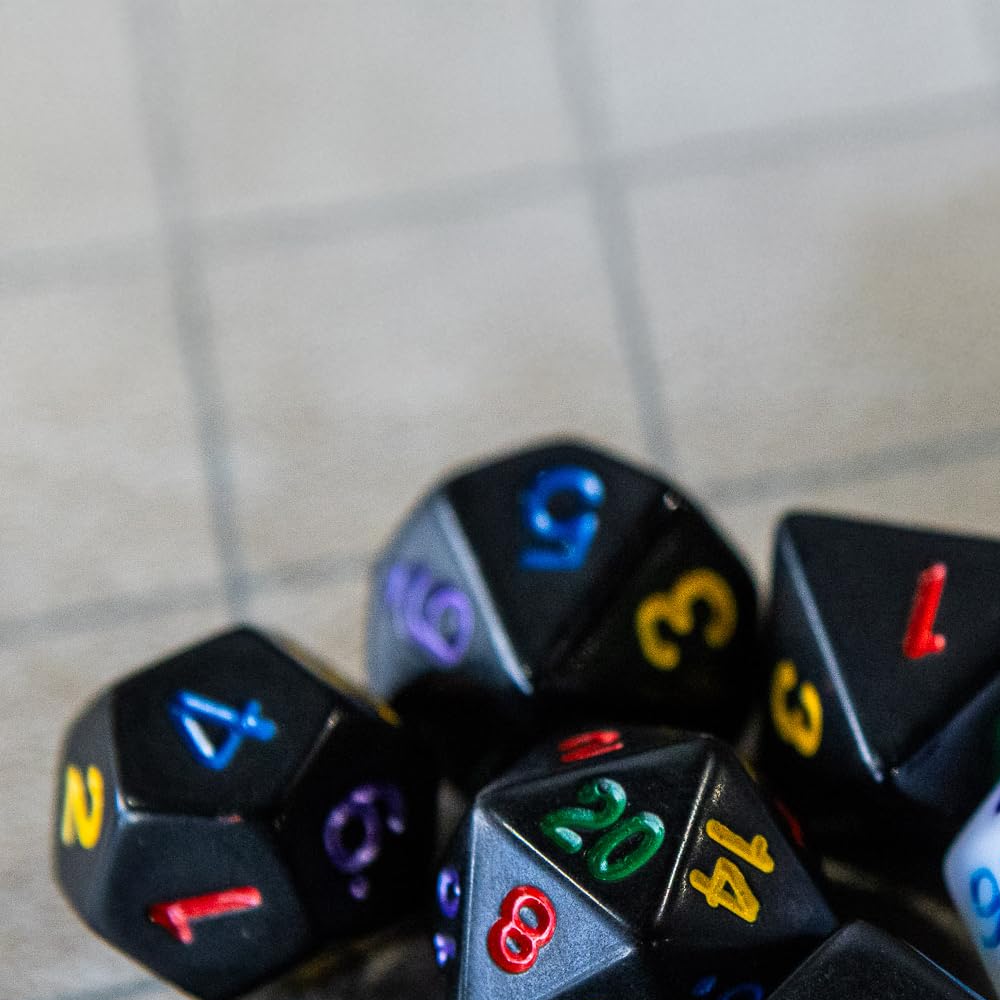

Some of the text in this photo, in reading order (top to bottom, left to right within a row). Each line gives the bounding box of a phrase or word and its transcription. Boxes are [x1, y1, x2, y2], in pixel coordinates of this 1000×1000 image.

[520, 466, 605, 571] 5
[635, 568, 736, 670] 3
[902, 562, 947, 659] 1
[167, 690, 277, 770] 4
[61, 765, 104, 849] 2
[540, 778, 665, 881] 20
[149, 886, 262, 944] 1
[689, 819, 774, 923] 14
[488, 885, 556, 974] 8
